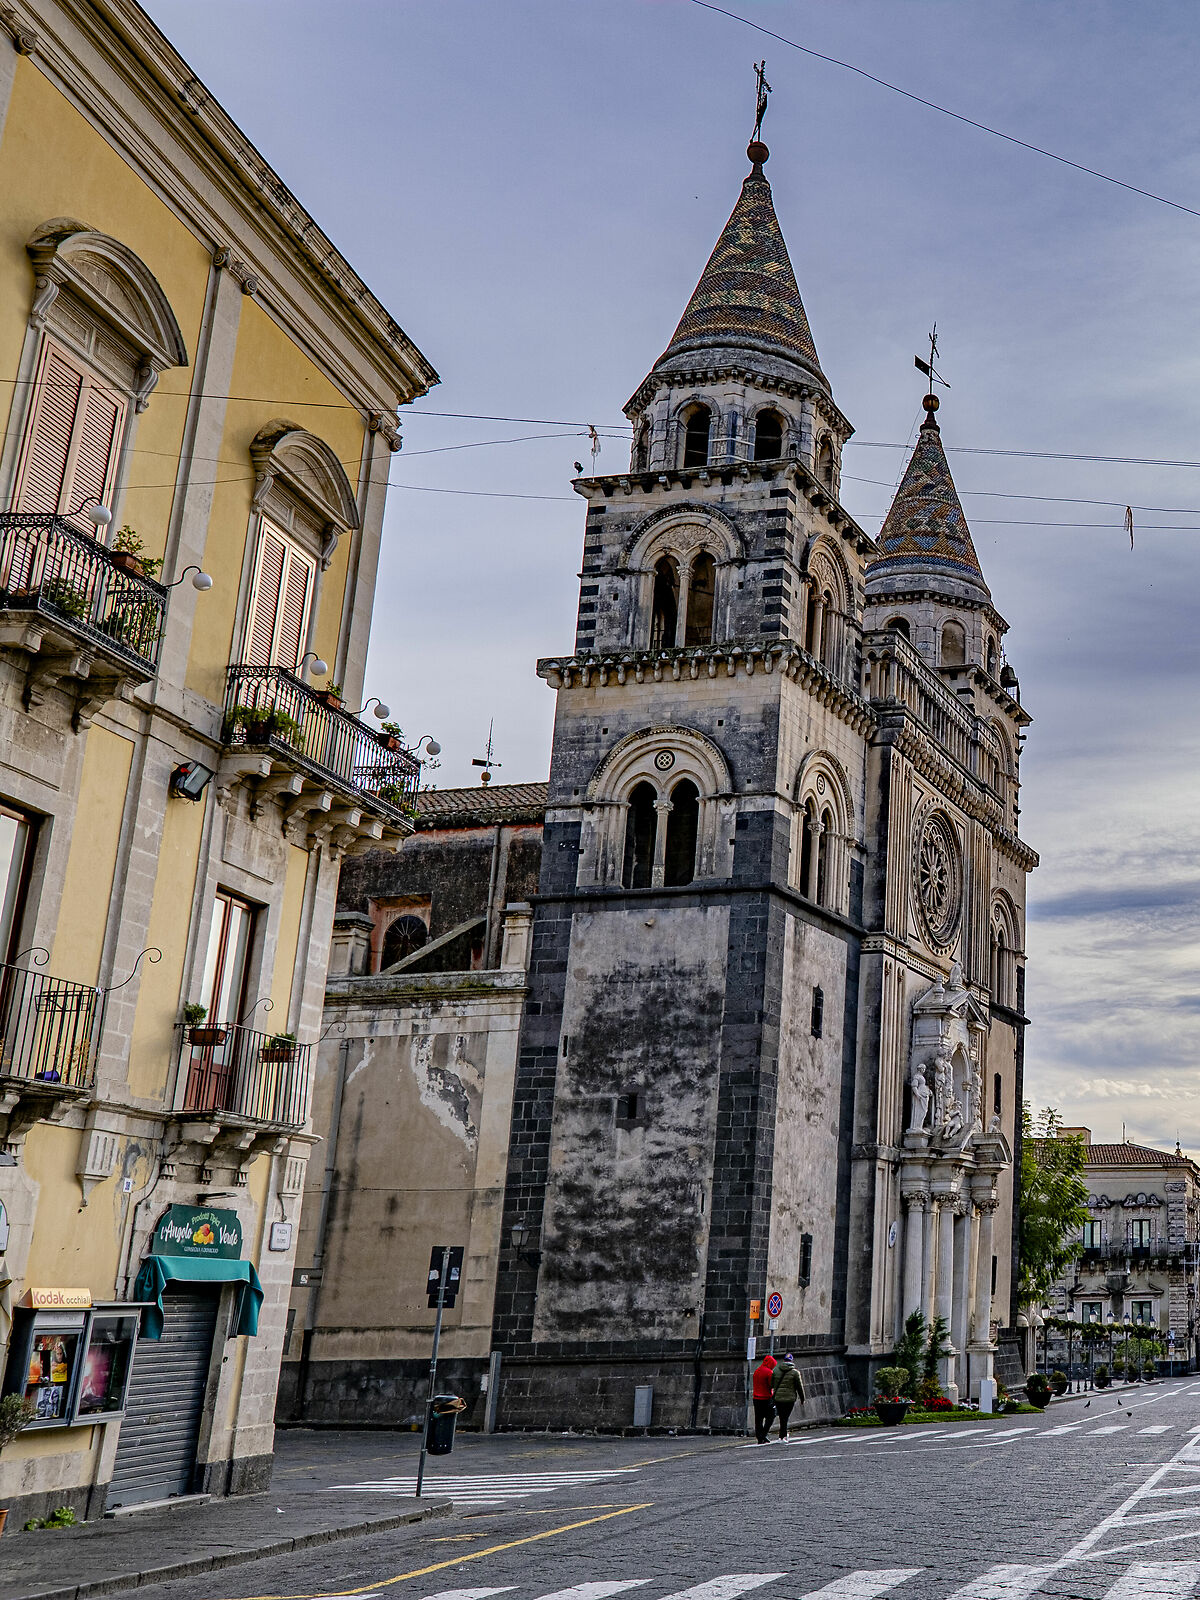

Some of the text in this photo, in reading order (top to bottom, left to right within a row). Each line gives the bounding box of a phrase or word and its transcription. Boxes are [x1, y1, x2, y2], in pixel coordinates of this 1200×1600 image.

[219, 1224, 238, 1246] Verde
[33, 1291, 91, 1305] Kodak occhiali
